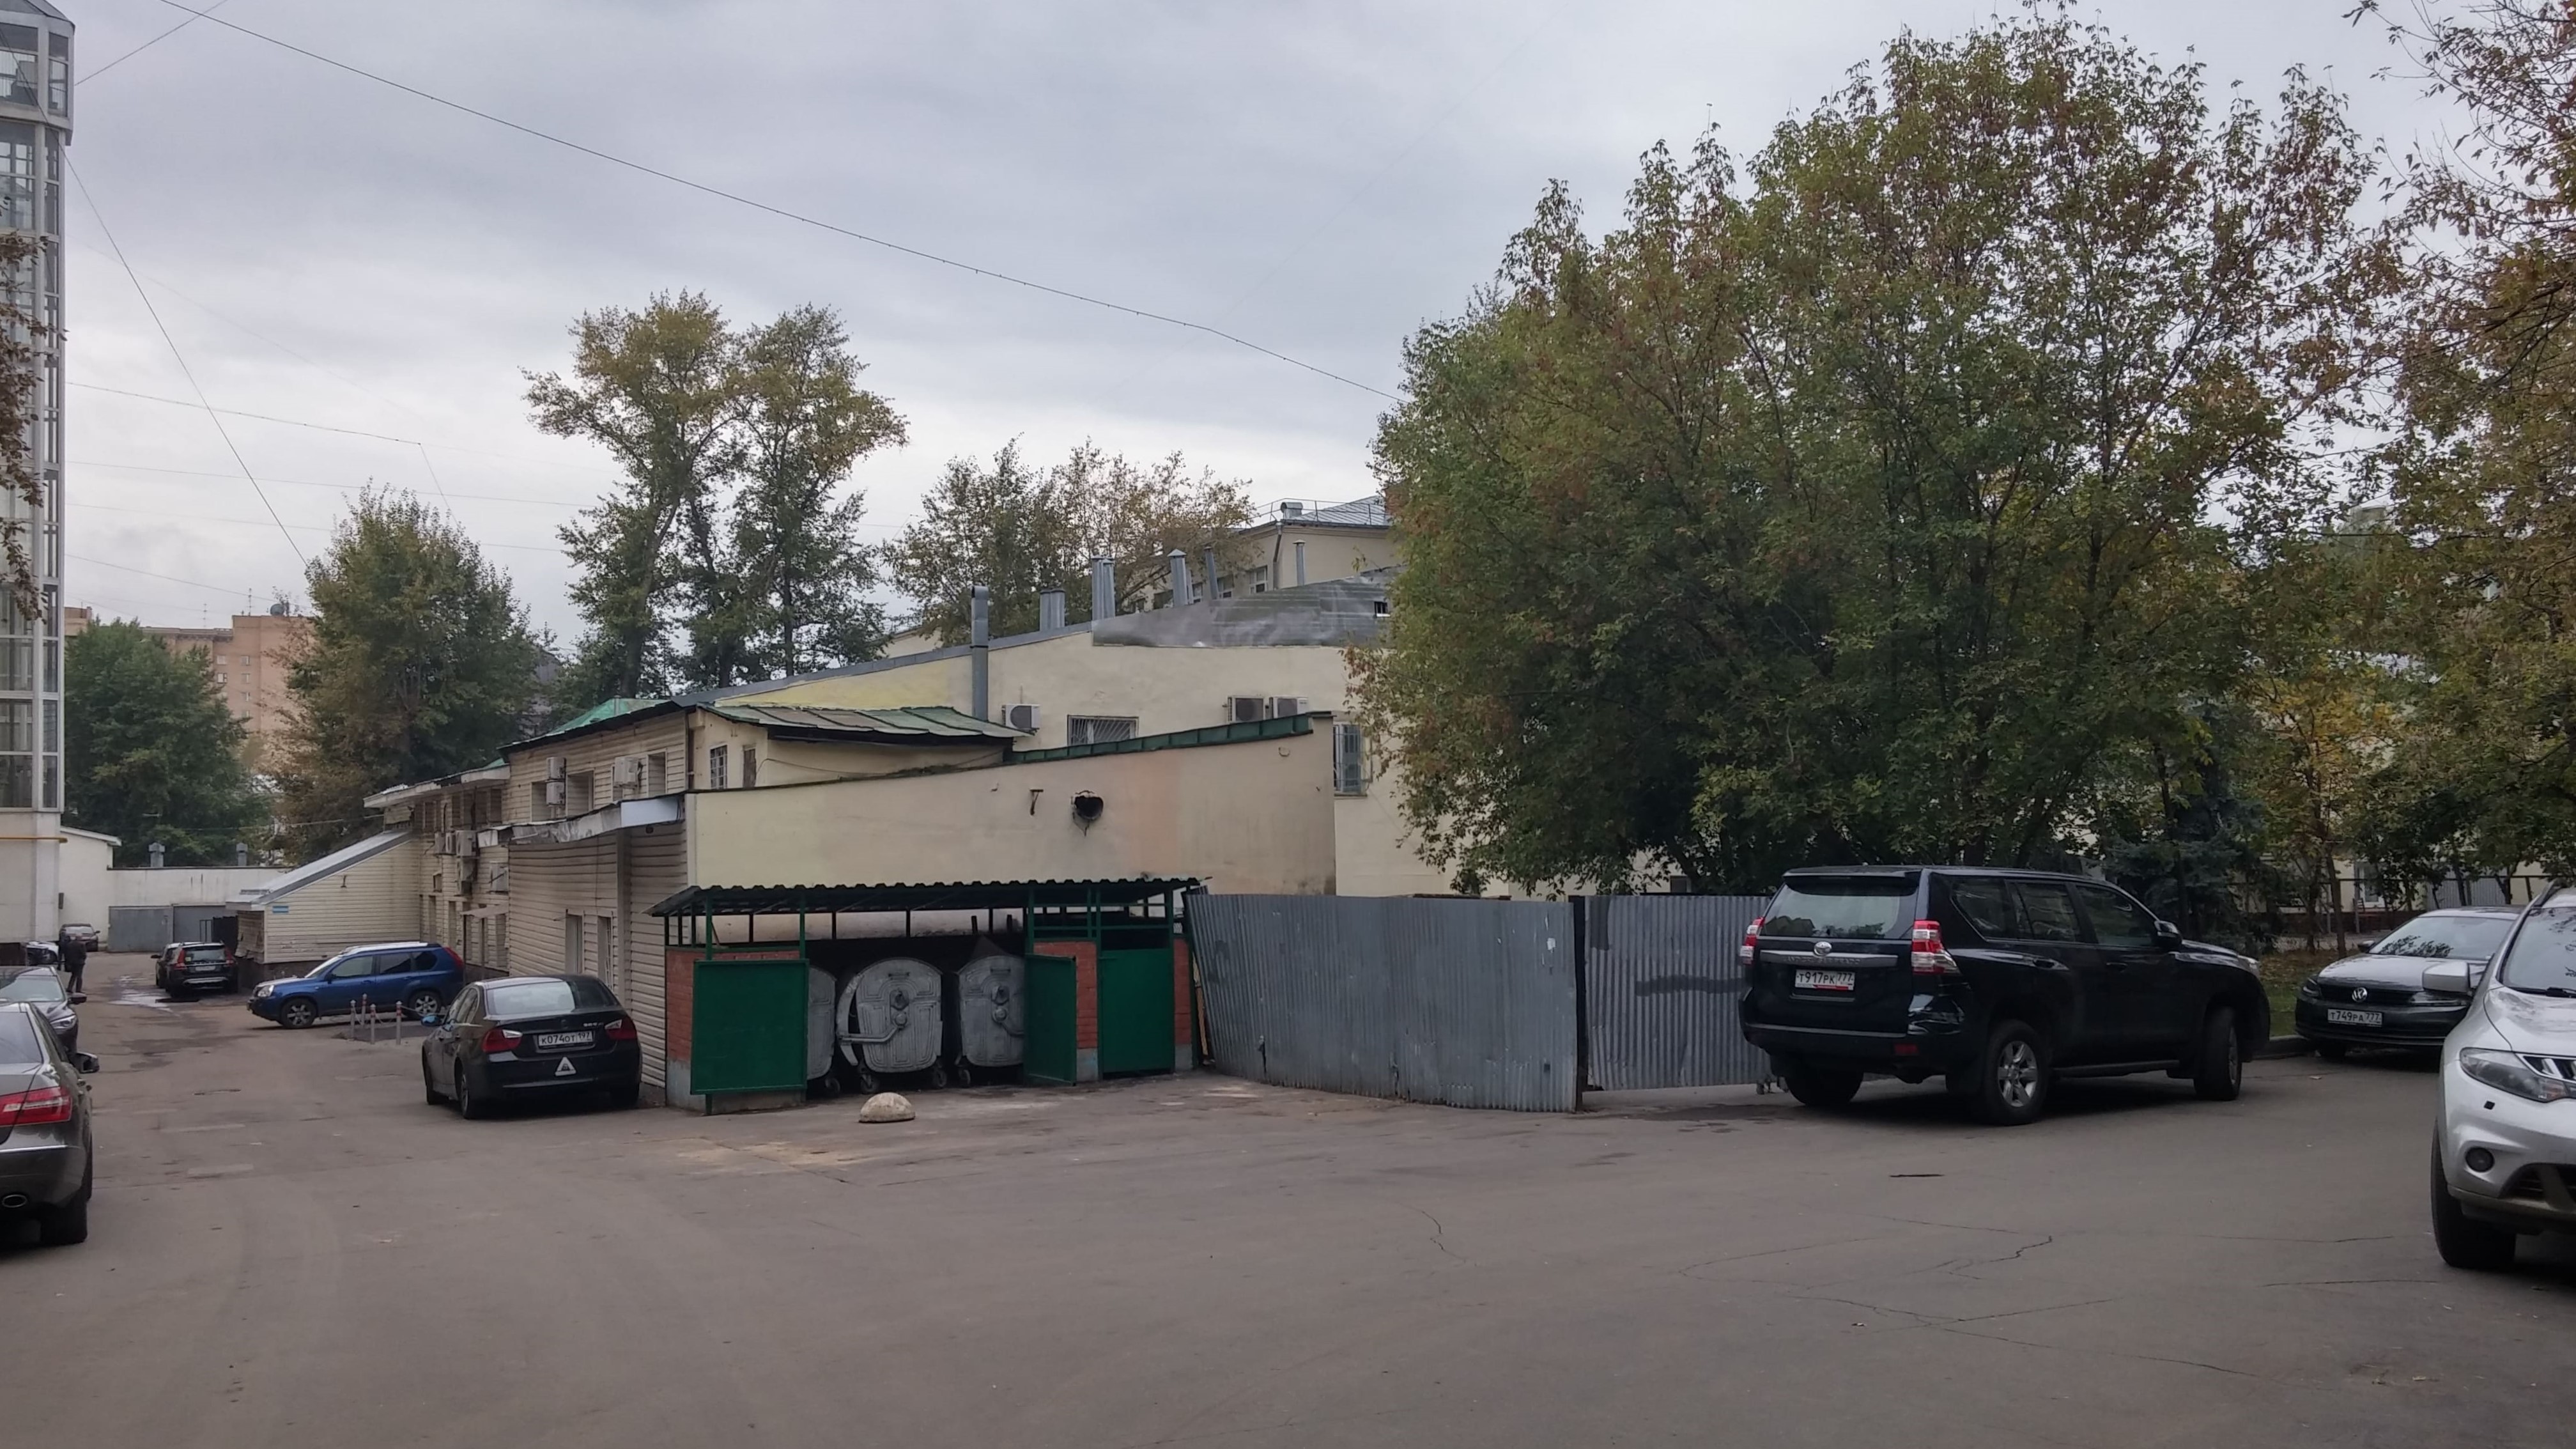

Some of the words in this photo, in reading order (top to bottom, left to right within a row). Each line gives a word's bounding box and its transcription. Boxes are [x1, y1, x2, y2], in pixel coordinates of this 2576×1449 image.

[1800, 972, 1835, 984] Т917РК
[1838, 972, 1852, 981] 777
[2331, 1011, 2364, 1021] Т749РА
[2366, 1012, 2380, 1021] 777
[541, 1034, 575, 1044] К074ОТ
